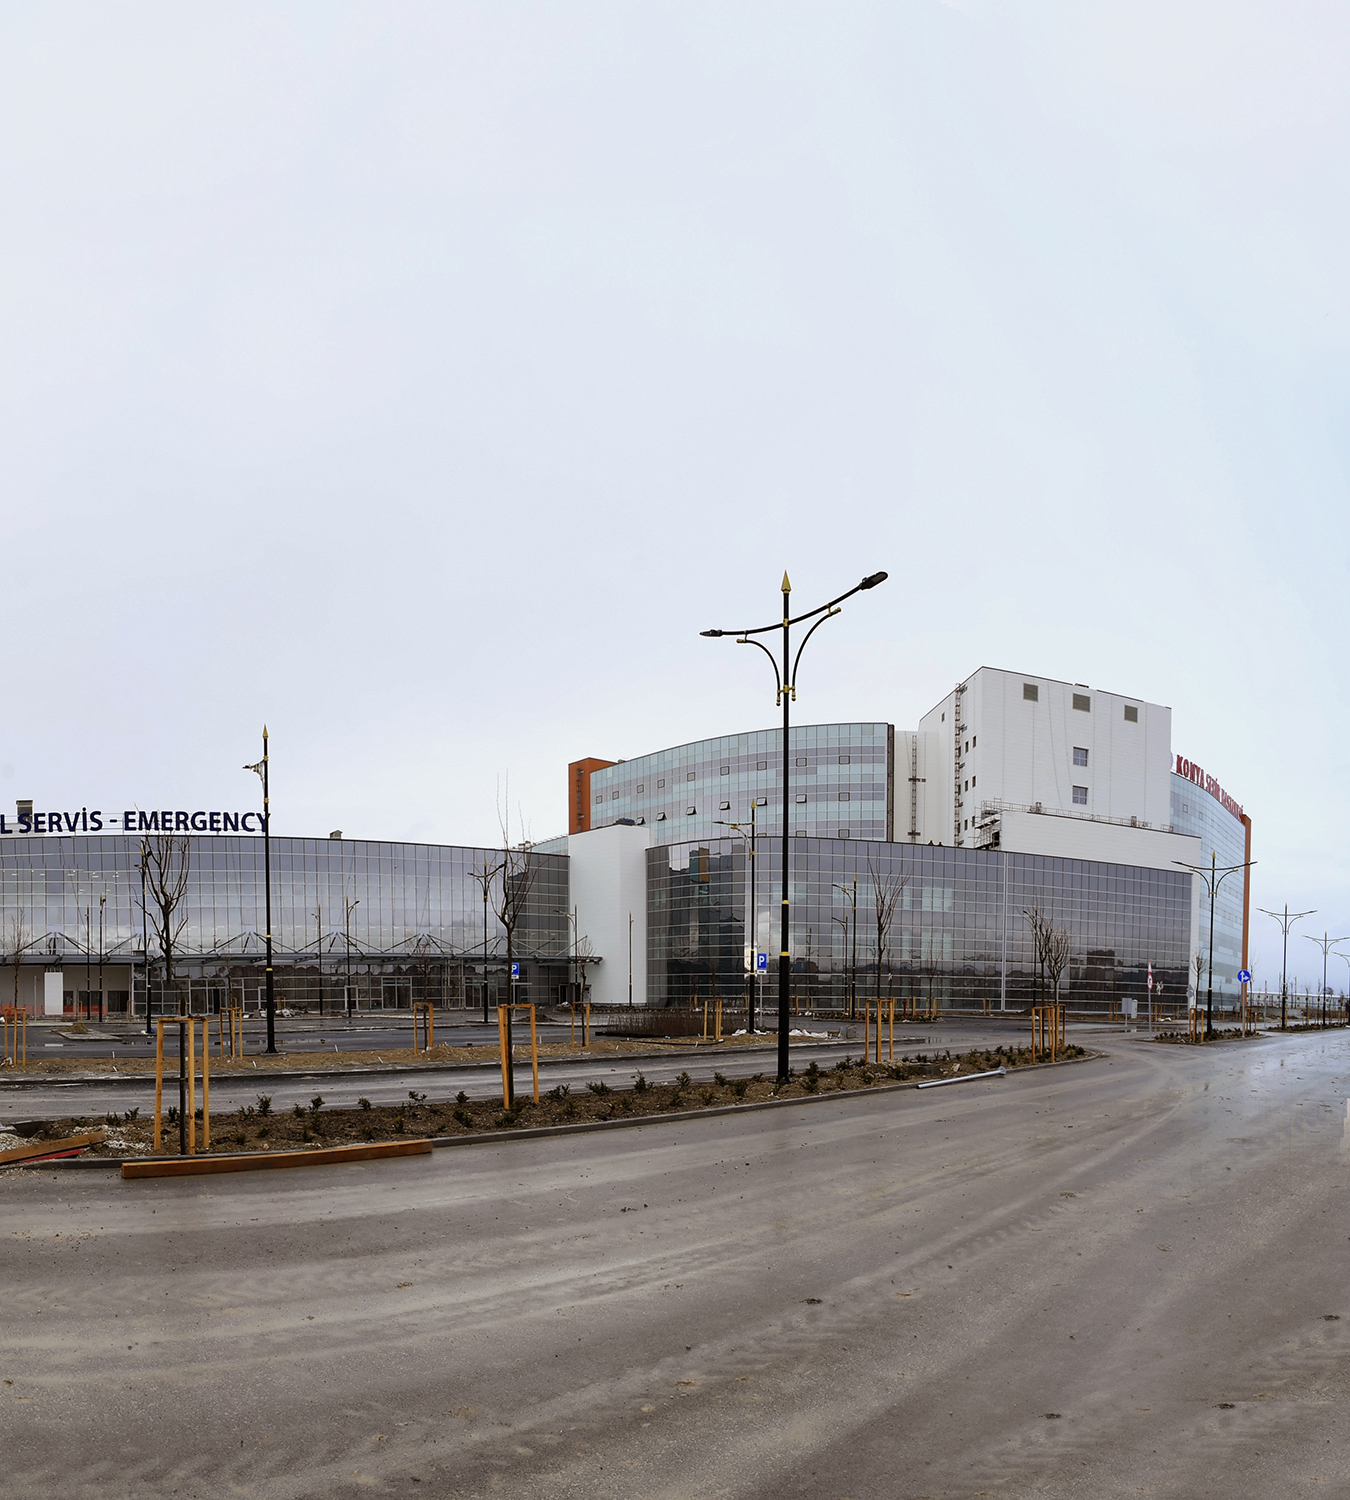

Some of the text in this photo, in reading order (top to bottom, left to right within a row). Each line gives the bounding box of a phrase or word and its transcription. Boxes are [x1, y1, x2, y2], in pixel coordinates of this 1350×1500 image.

[1176, 754, 1205, 789] KONYA
[17, 806, 103, 834] SERVİS
[124, 811, 271, 832] EMERGENCY
